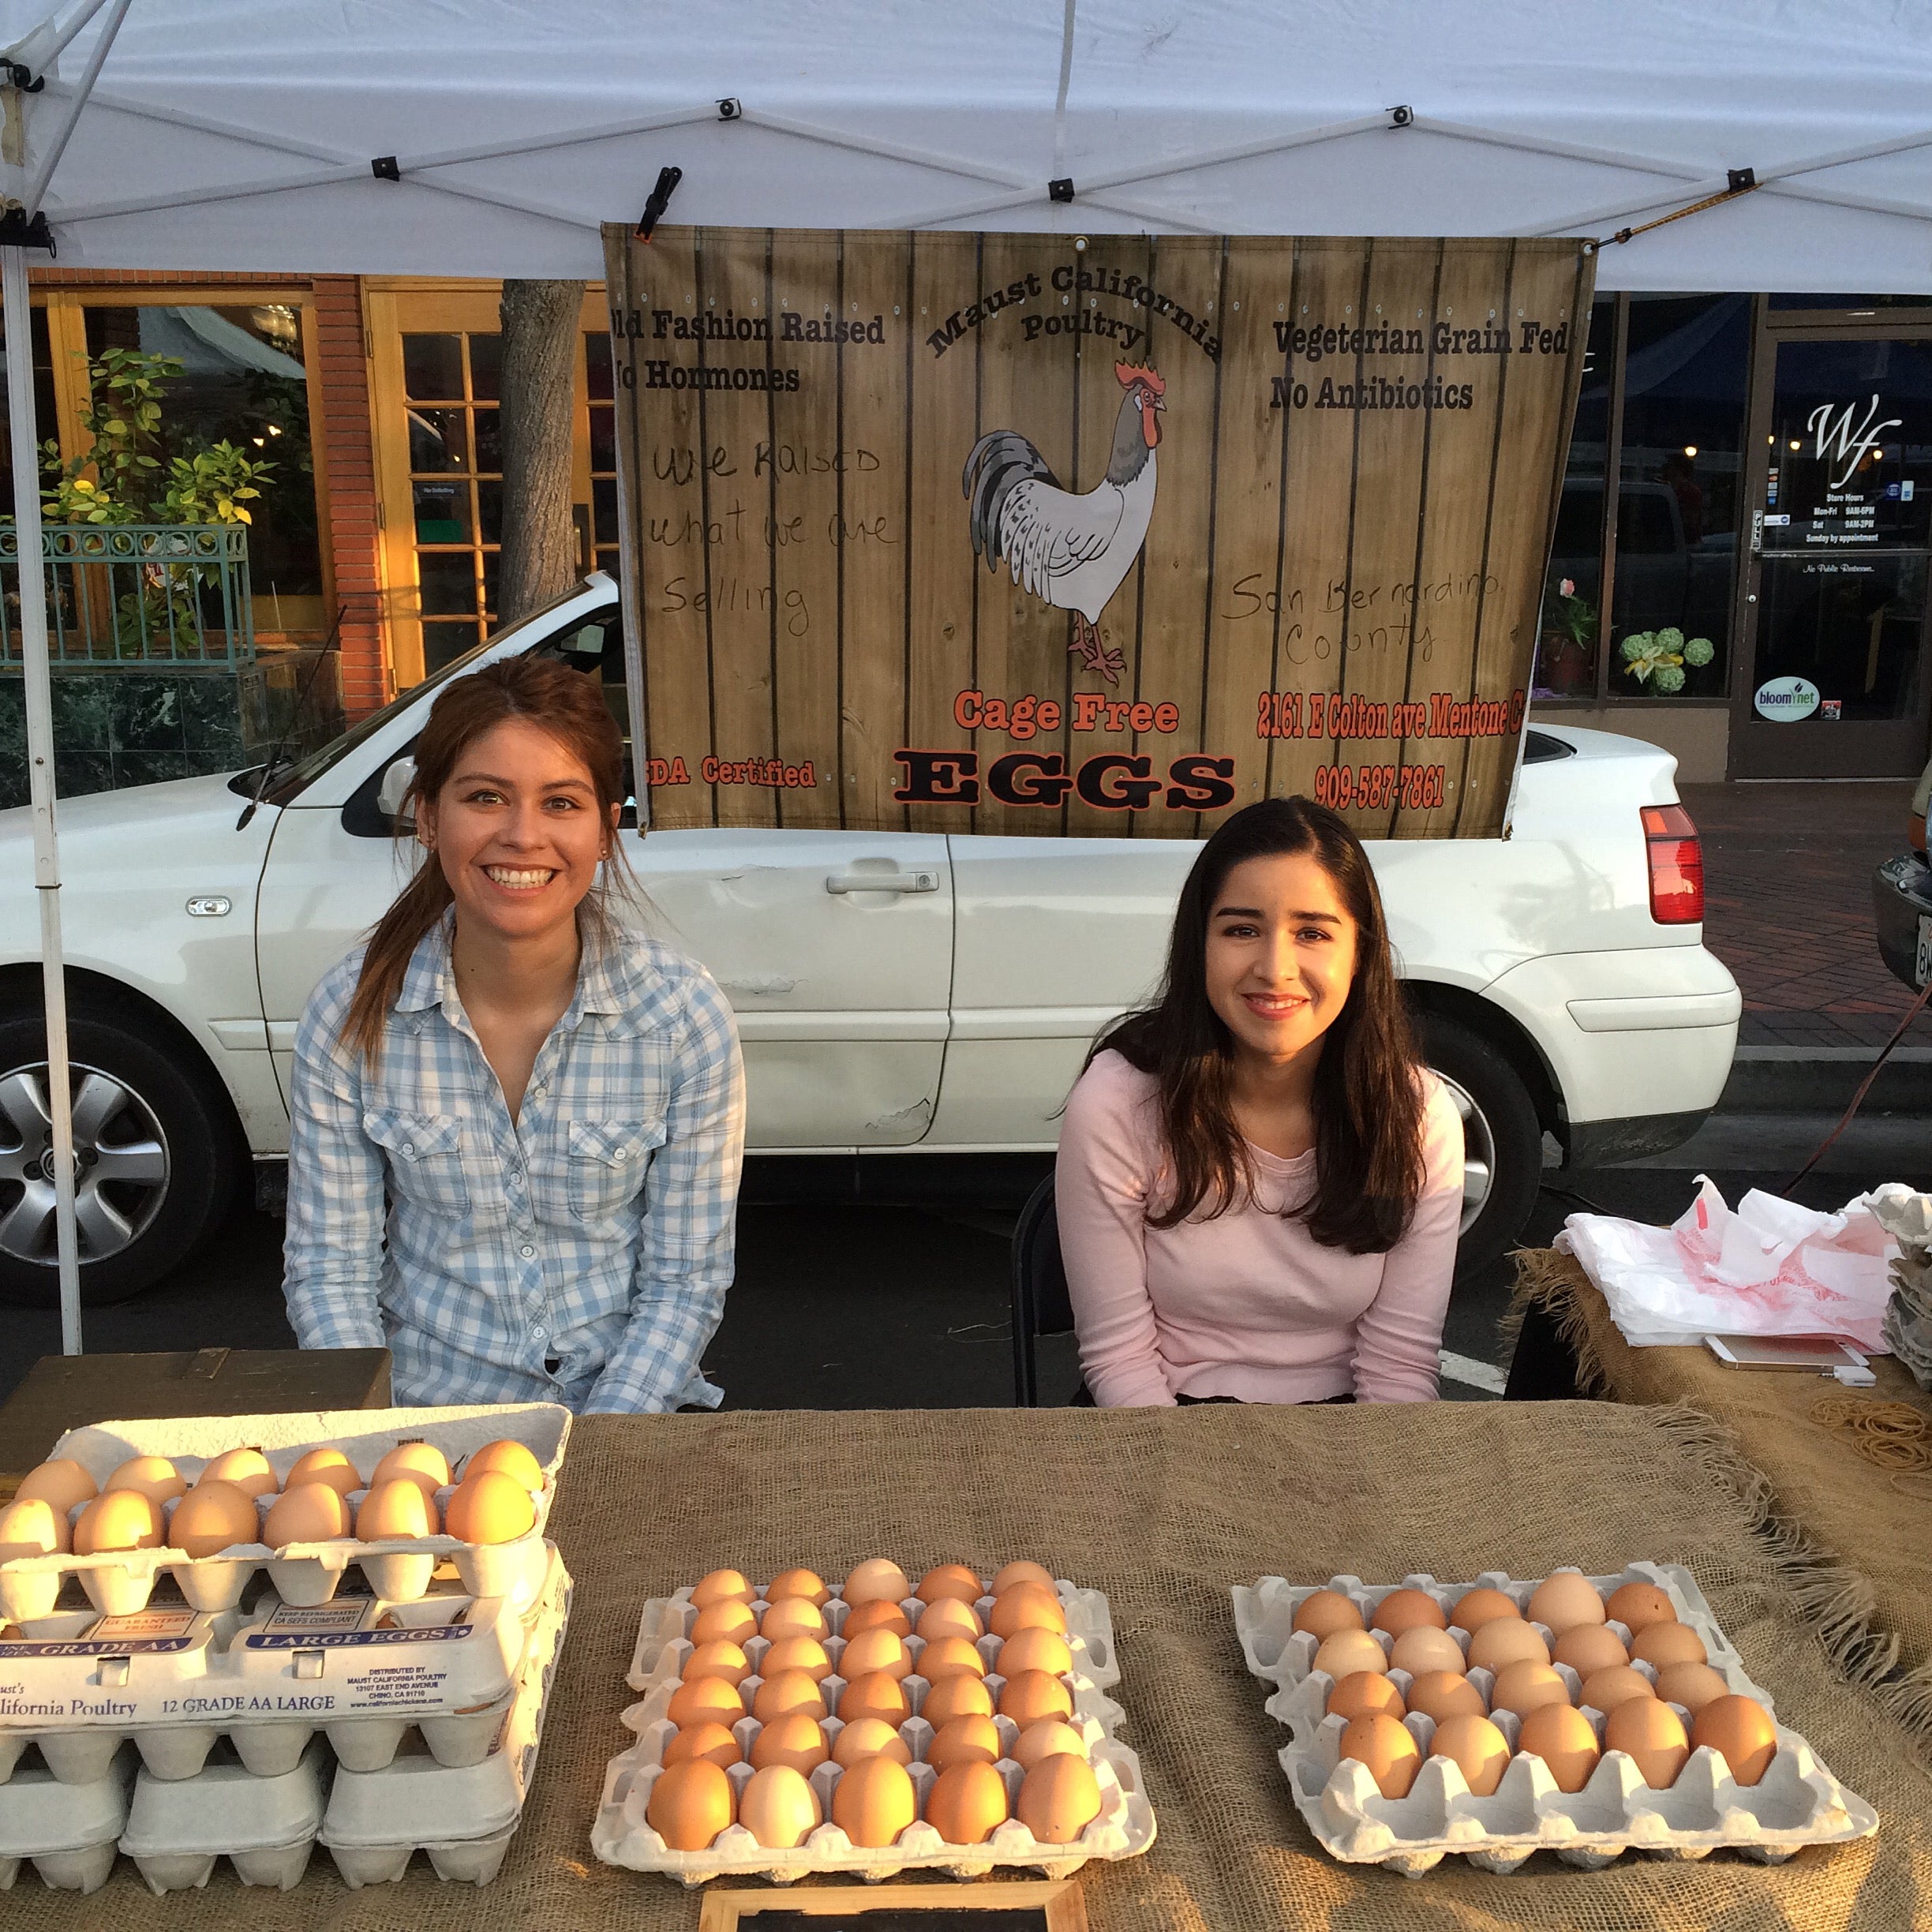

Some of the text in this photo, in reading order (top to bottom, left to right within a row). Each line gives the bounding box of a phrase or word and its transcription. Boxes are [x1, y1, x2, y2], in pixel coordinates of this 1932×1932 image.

[651, 309, 773, 341] Fashion
[781, 311, 886, 344] Raised
[926, 265, 1222, 365] Maust California
[1021, 309, 1145, 350] Poultry
[1272, 320, 1569, 362] Vegeterian Grain Fed
[645, 359, 800, 392] Hormones
[1269, 375, 1473, 410] No Antibiotics
[1826, 493, 1864, 502] Store Hours
[1806, 533, 1879, 545] Sunday by appointment
[1812, 520, 1825, 529] Sat
[1221, 572, 1304, 619] San
[953, 689, 1180, 740] Cage Free
[1256, 688, 1526, 739] 2161 E Colton ave Mentone C
[701, 754, 818, 788] Certified
[893, 747, 1236, 812] EGGS
[1315, 764, 1445, 811] 909-587-7861
[105, 1616, 191, 1625] GUARANTEED
[309, 1615, 357, 1624] COMPLIANT
[39, 1641, 180, 1655] GRADE AA
[260, 1634, 361, 1647] LARGE
[369, 1629, 445, 1642] EGGS
[369, 1667, 414, 1676] DISTRIBUTED
[373, 1675, 414, 1683] CALIFORNIA
[70, 1698, 137, 1719] Poultry
[163, 1695, 335, 1713] 12 GRADE AA LARGE
